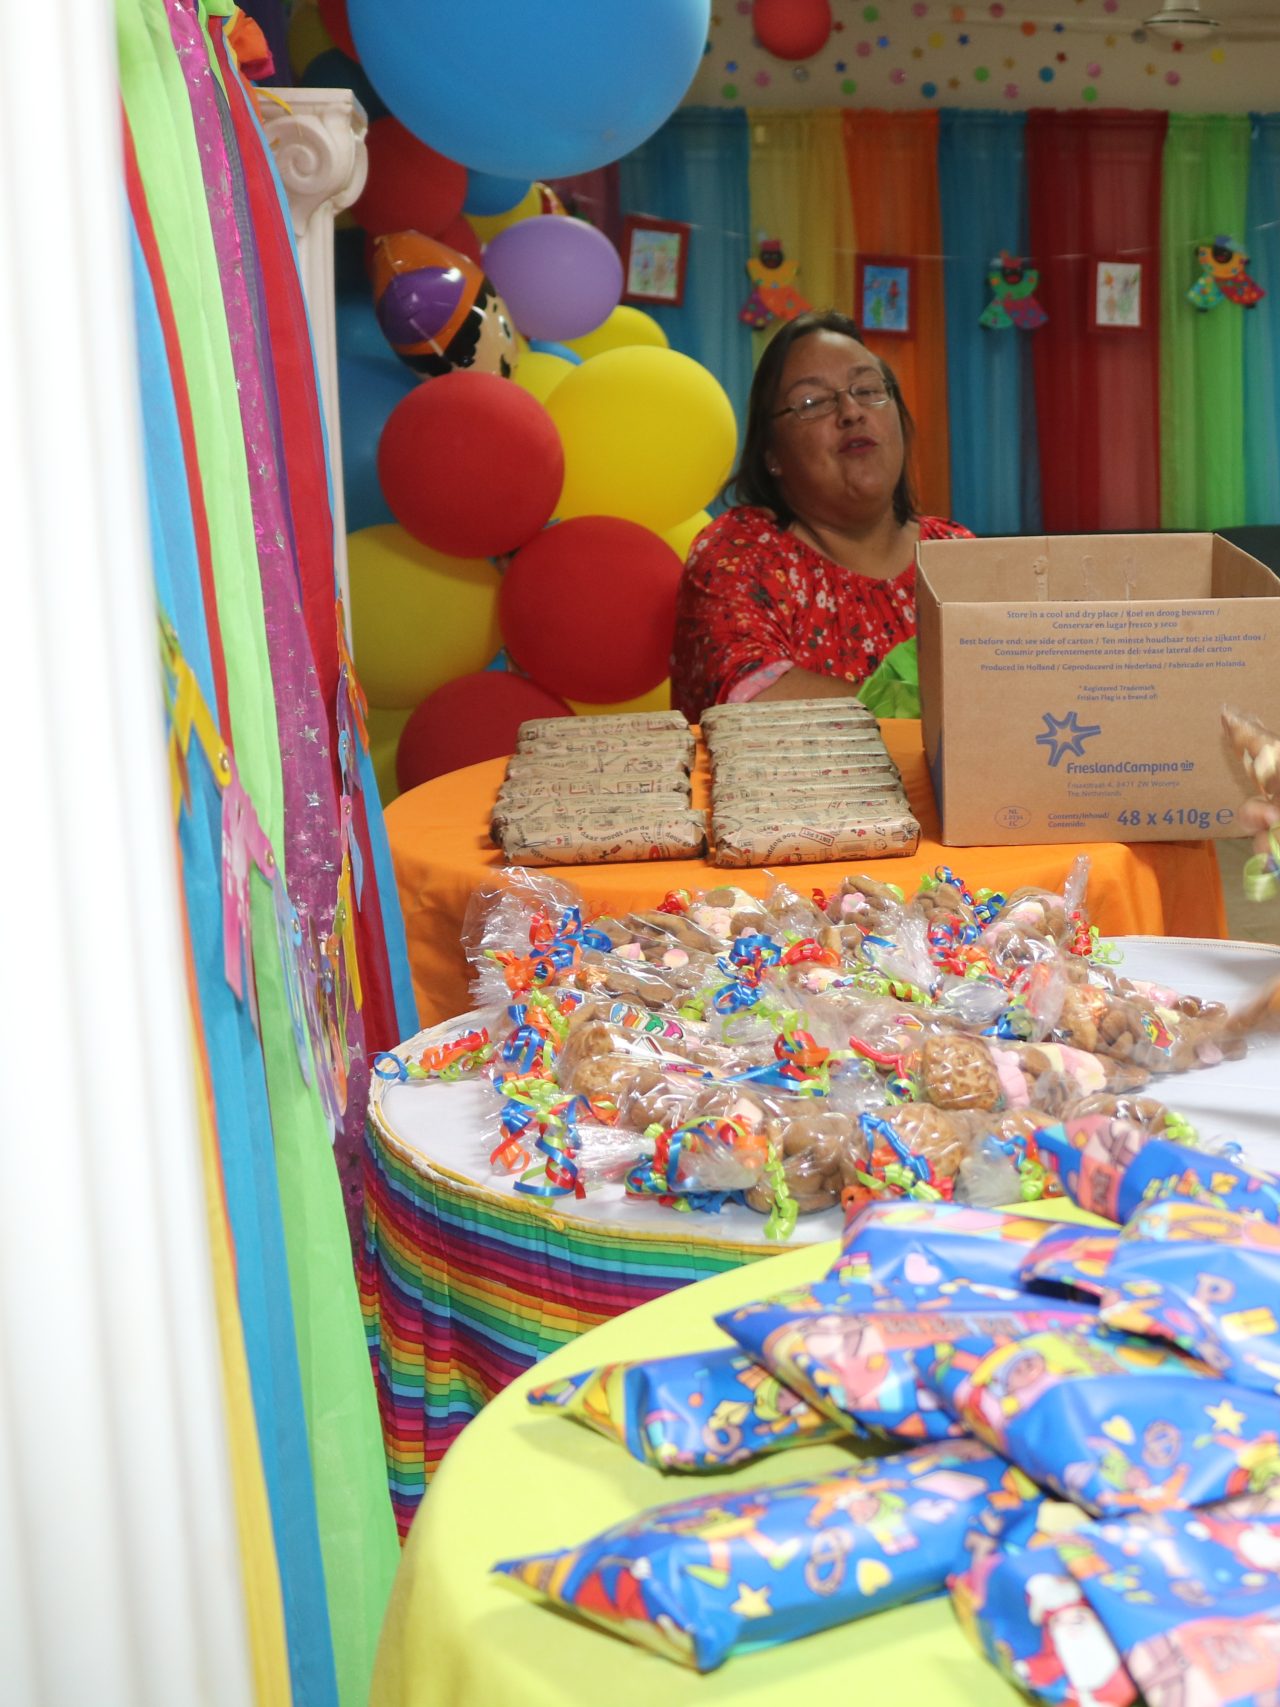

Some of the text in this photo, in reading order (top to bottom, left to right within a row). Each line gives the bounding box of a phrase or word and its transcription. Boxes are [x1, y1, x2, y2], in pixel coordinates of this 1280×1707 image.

[1007, 610, 1028, 619] Store
[1030, 610, 1038, 619] in
[1046, 610, 1063, 618] cool
[1065, 610, 1080, 618] and
[1082, 610, 1096, 620] dry
[1098, 608, 1118, 620] place
[1126, 609, 1144, 618] Koel
[1156, 608, 1180, 619] droog
[1181, 608, 1215, 617] bewaren
[1052, 622, 1094, 630] Conservar
[1106, 621, 1128, 630] lugar
[1154, 622, 1158, 630] y
[960, 638, 976, 646] Best
[978, 637, 1004, 646] before
[1006, 636, 1023, 645] end:
[1025, 638, 1038, 646] see
[1056, 636, 1066, 645] of
[1066, 637, 1094, 645] carton
[1102, 636, 1116, 645] Ten
[1118, 636, 1144, 644] minste
[1146, 636, 1184, 644] houdbaar
[1186, 635, 1200, 643] tot:
[1214, 634, 1240, 642] zijkant
[994, 648, 1034, 656] Consumir
[1036, 648, 1102, 657] preferentemente
[1104, 648, 1125, 656] antes
[1143, 646, 1164, 654] véase
[1166, 646, 1191, 654] lateral
[1194, 646, 1205, 654] del
[980, 664, 1016, 672] Produced
[1016, 664, 1024, 672] in
[1026, 664, 1056, 672] Holland
[1062, 663, 1114, 673] Geproduceerd
[1124, 662, 1162, 670] Nederland
[1216, 660, 1246, 668] Holanda
[1083, 684, 1118, 693] Registered
[1120, 684, 1155, 692] Trademark
[1101, 694, 1115, 702] Flag
[1066, 760, 1178, 776] FrieslandCampina
[1068, 790, 1122, 798] The Netherlands
[1117, 810, 1141, 826] 48
[1146, 812, 1157, 826] x
[1162, 808, 1211, 829] 410g
[600, 830, 624, 842] wordt
